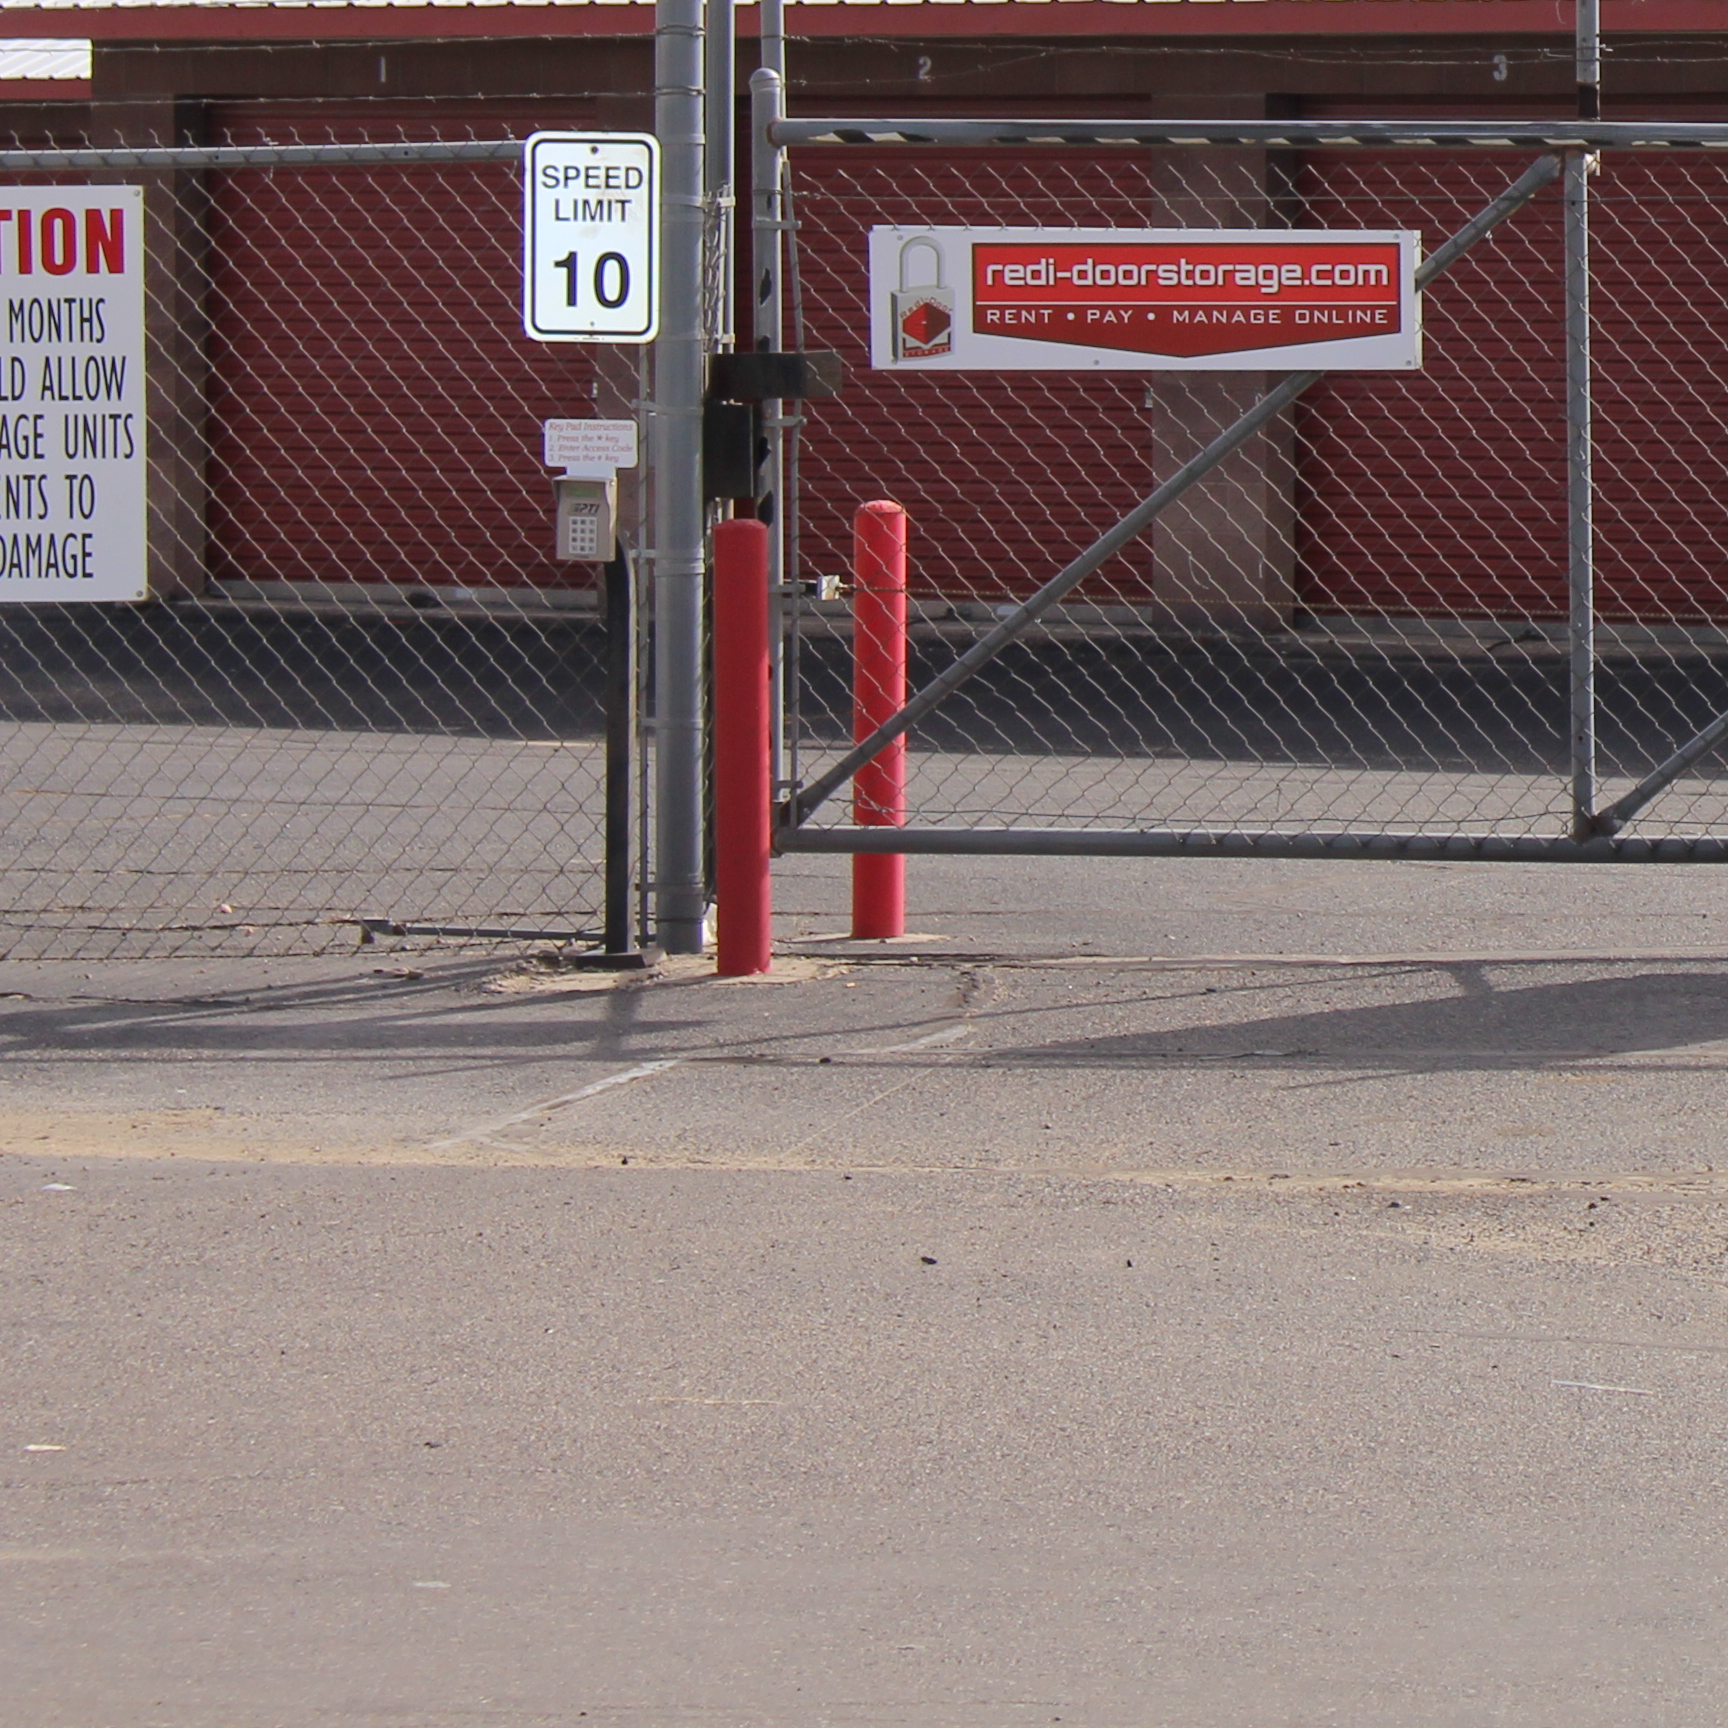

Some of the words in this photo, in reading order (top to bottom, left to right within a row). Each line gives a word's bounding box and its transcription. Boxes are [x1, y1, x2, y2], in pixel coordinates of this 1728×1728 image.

[918, 56, 932, 80] 2
[1493, 54, 1508, 81] 3
[541, 165, 644, 189] SPEED
[554, 199, 632, 222] LIMIT
[553, 250, 630, 309] 10
[986, 258, 1389, 294] redi-doorstorage.com
[8, 297, 105, 343] MONTHS
[987, 310, 1053, 323] RENT
[1087, 310, 1133, 323] PAY
[1172, 310, 1281, 323] MANAGE
[1295, 310, 1388, 323] ONLINE
[41, 355, 126, 401] ALLOW
[65, 413, 134, 459] UNITS
[0, 474, 48, 520] NTS
[65, 474, 95, 520] TO
